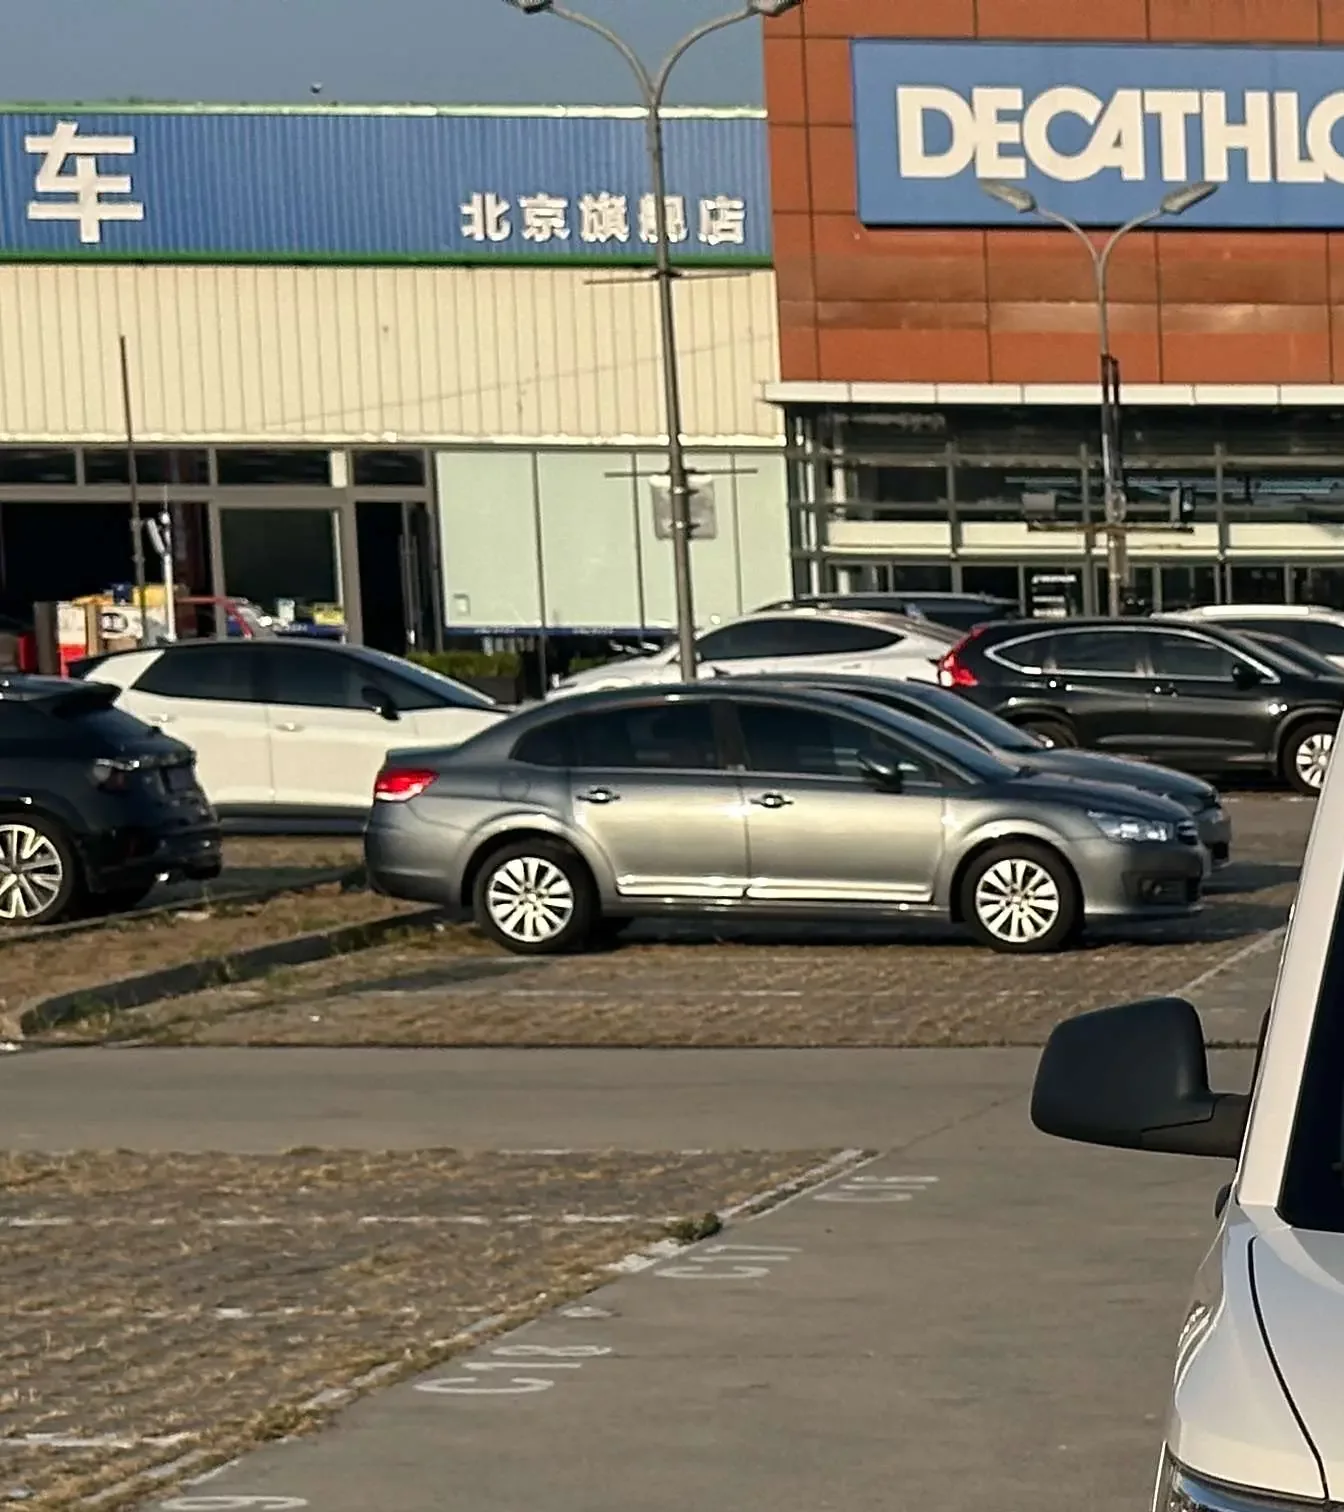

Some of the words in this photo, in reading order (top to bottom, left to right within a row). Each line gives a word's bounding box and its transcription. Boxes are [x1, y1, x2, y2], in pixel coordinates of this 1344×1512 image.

[24, 120, 144, 243] 车
[459, 191, 746, 245] 北京旗舰店
[413, 1345, 612, 1394] C18
